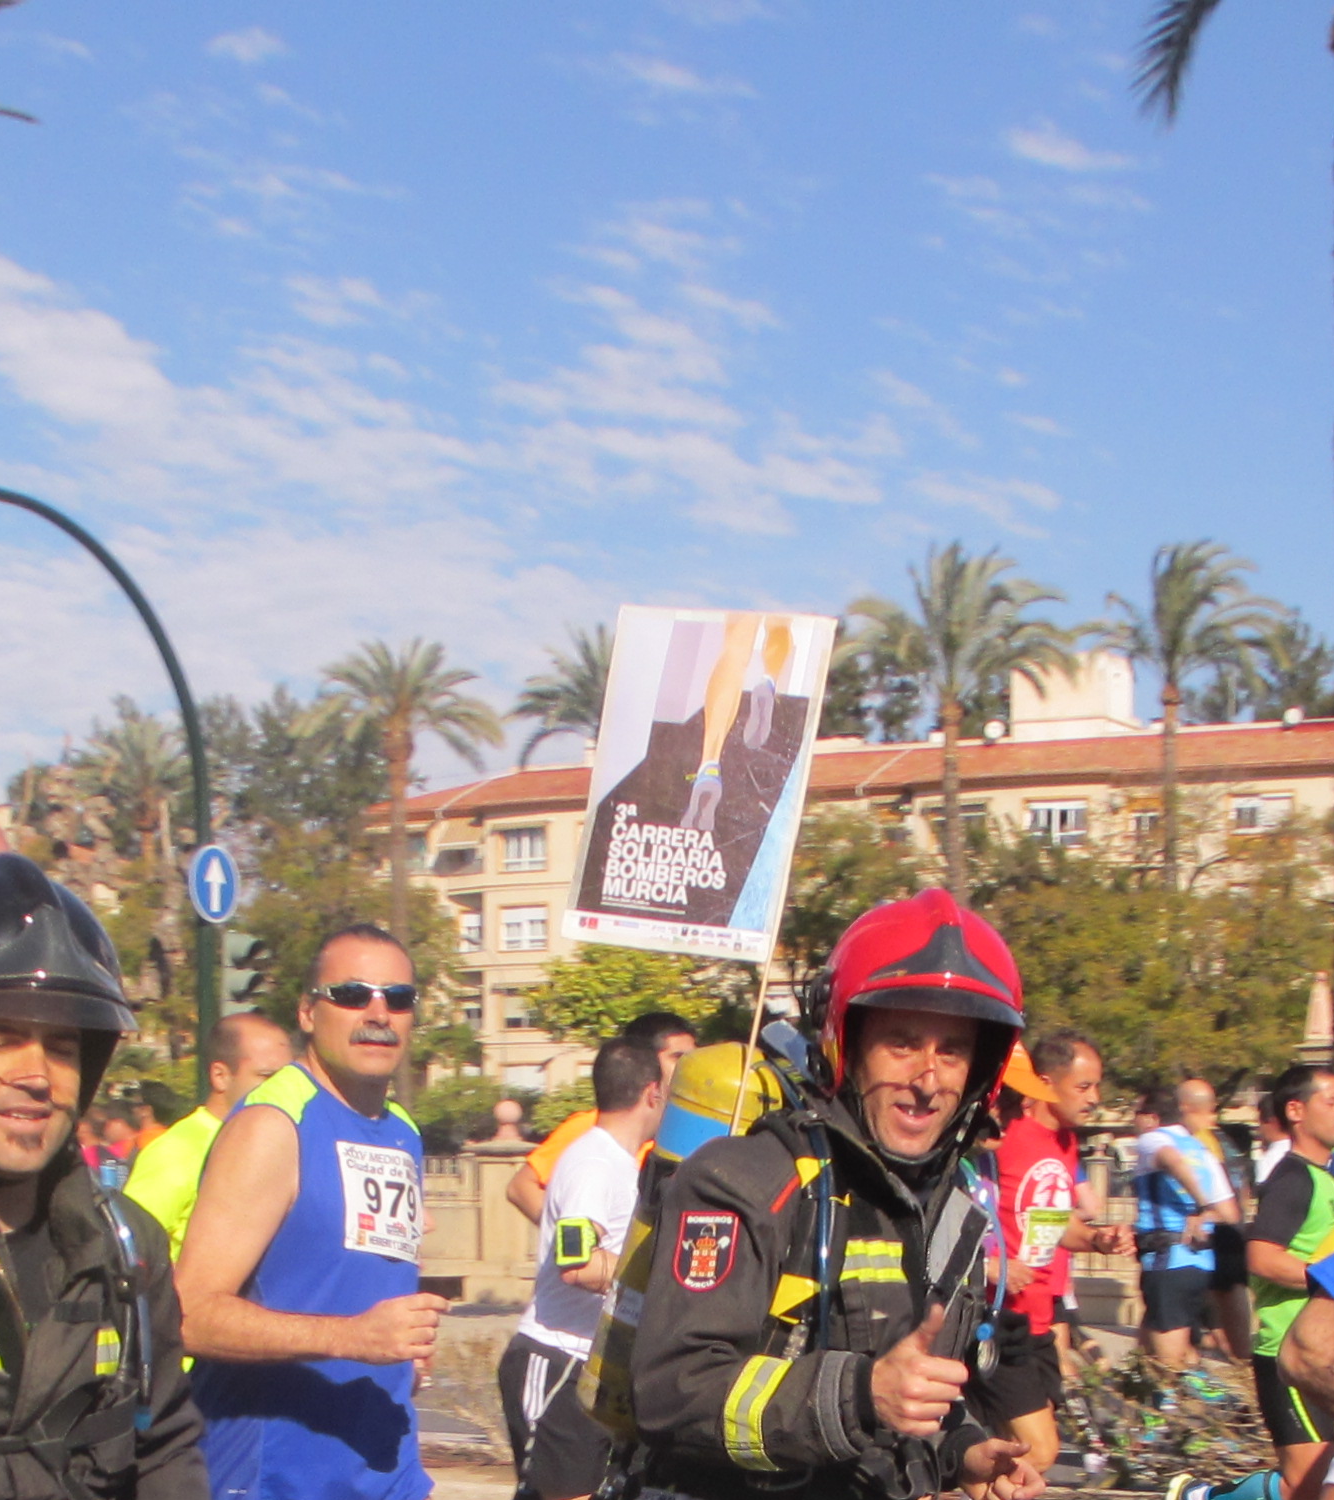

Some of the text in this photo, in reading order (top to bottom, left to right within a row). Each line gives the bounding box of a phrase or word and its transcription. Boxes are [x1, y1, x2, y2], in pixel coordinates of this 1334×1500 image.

[611, 822, 714, 851] CARRERA
[608, 840, 723, 871] SOLIDARIA
[605, 858, 727, 890] BOMBEROS
[602, 876, 688, 905] MURCIA
[347, 1159, 384, 1174] Ciudad
[364, 1177, 417, 1223] 979
[687, 1216, 733, 1224] BOMBEROS
